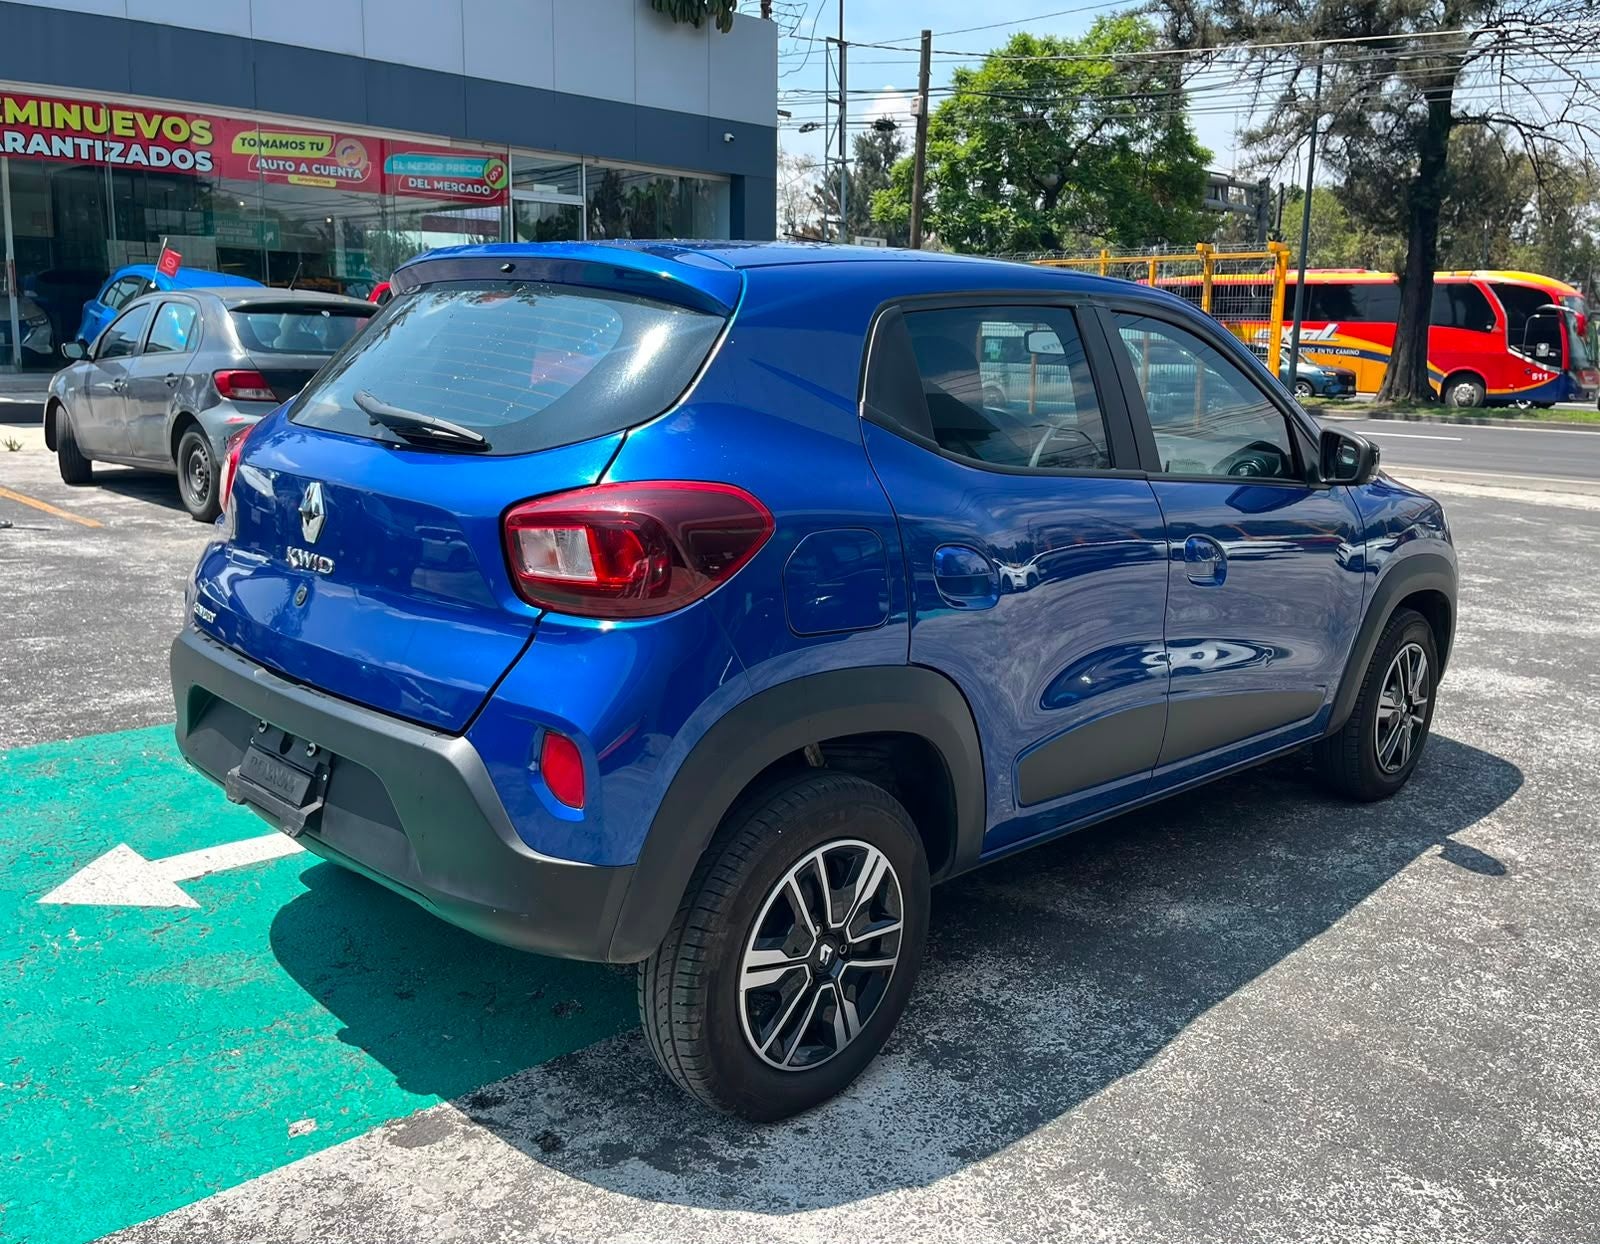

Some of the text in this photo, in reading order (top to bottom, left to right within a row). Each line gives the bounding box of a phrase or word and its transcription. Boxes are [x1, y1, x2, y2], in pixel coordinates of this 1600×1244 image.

[0, 97, 213, 145] MINUEVOS
[240, 137, 324, 152] TOMAMOS TU
[256, 158, 363, 179] AUTO A CUENTA
[392, 160, 482, 173] EL MEJOR PRECIO
[408, 178, 490, 195] DEL MERCADO
[1531, 372, 1548, 381] 511
[286, 546, 335, 574] KWID
